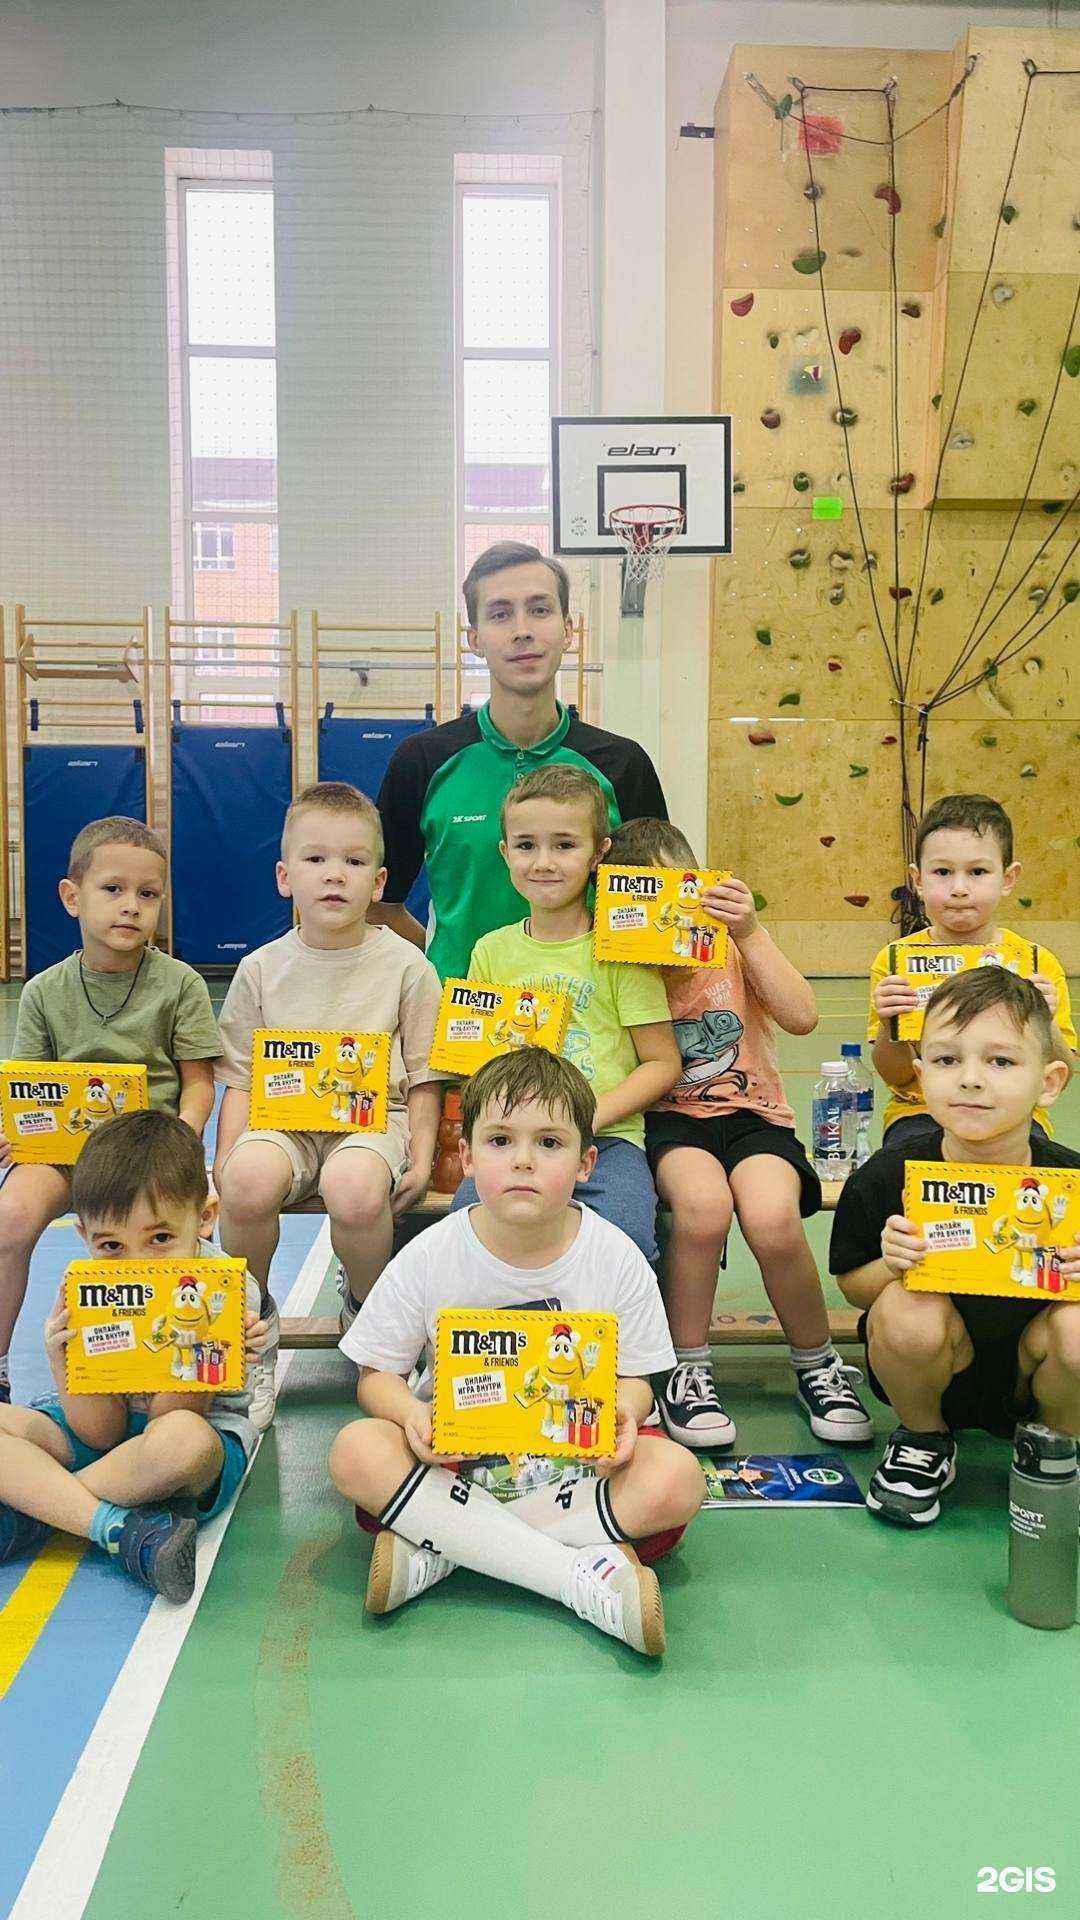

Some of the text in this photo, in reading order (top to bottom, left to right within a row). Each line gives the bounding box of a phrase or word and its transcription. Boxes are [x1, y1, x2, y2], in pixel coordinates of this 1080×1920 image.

[607, 443, 676, 457] elan
[827, 1106, 840, 1161] BAIKAL
[960, 1206, 988, 1216] FRIENDS
[118, 1308, 146, 1317] FRIENDS
[490, 1358, 519, 1367] FRIENDS
[457, 1385, 475, 1395] ИГРА
[476, 1382, 502, 1392] ВНУТРИ
